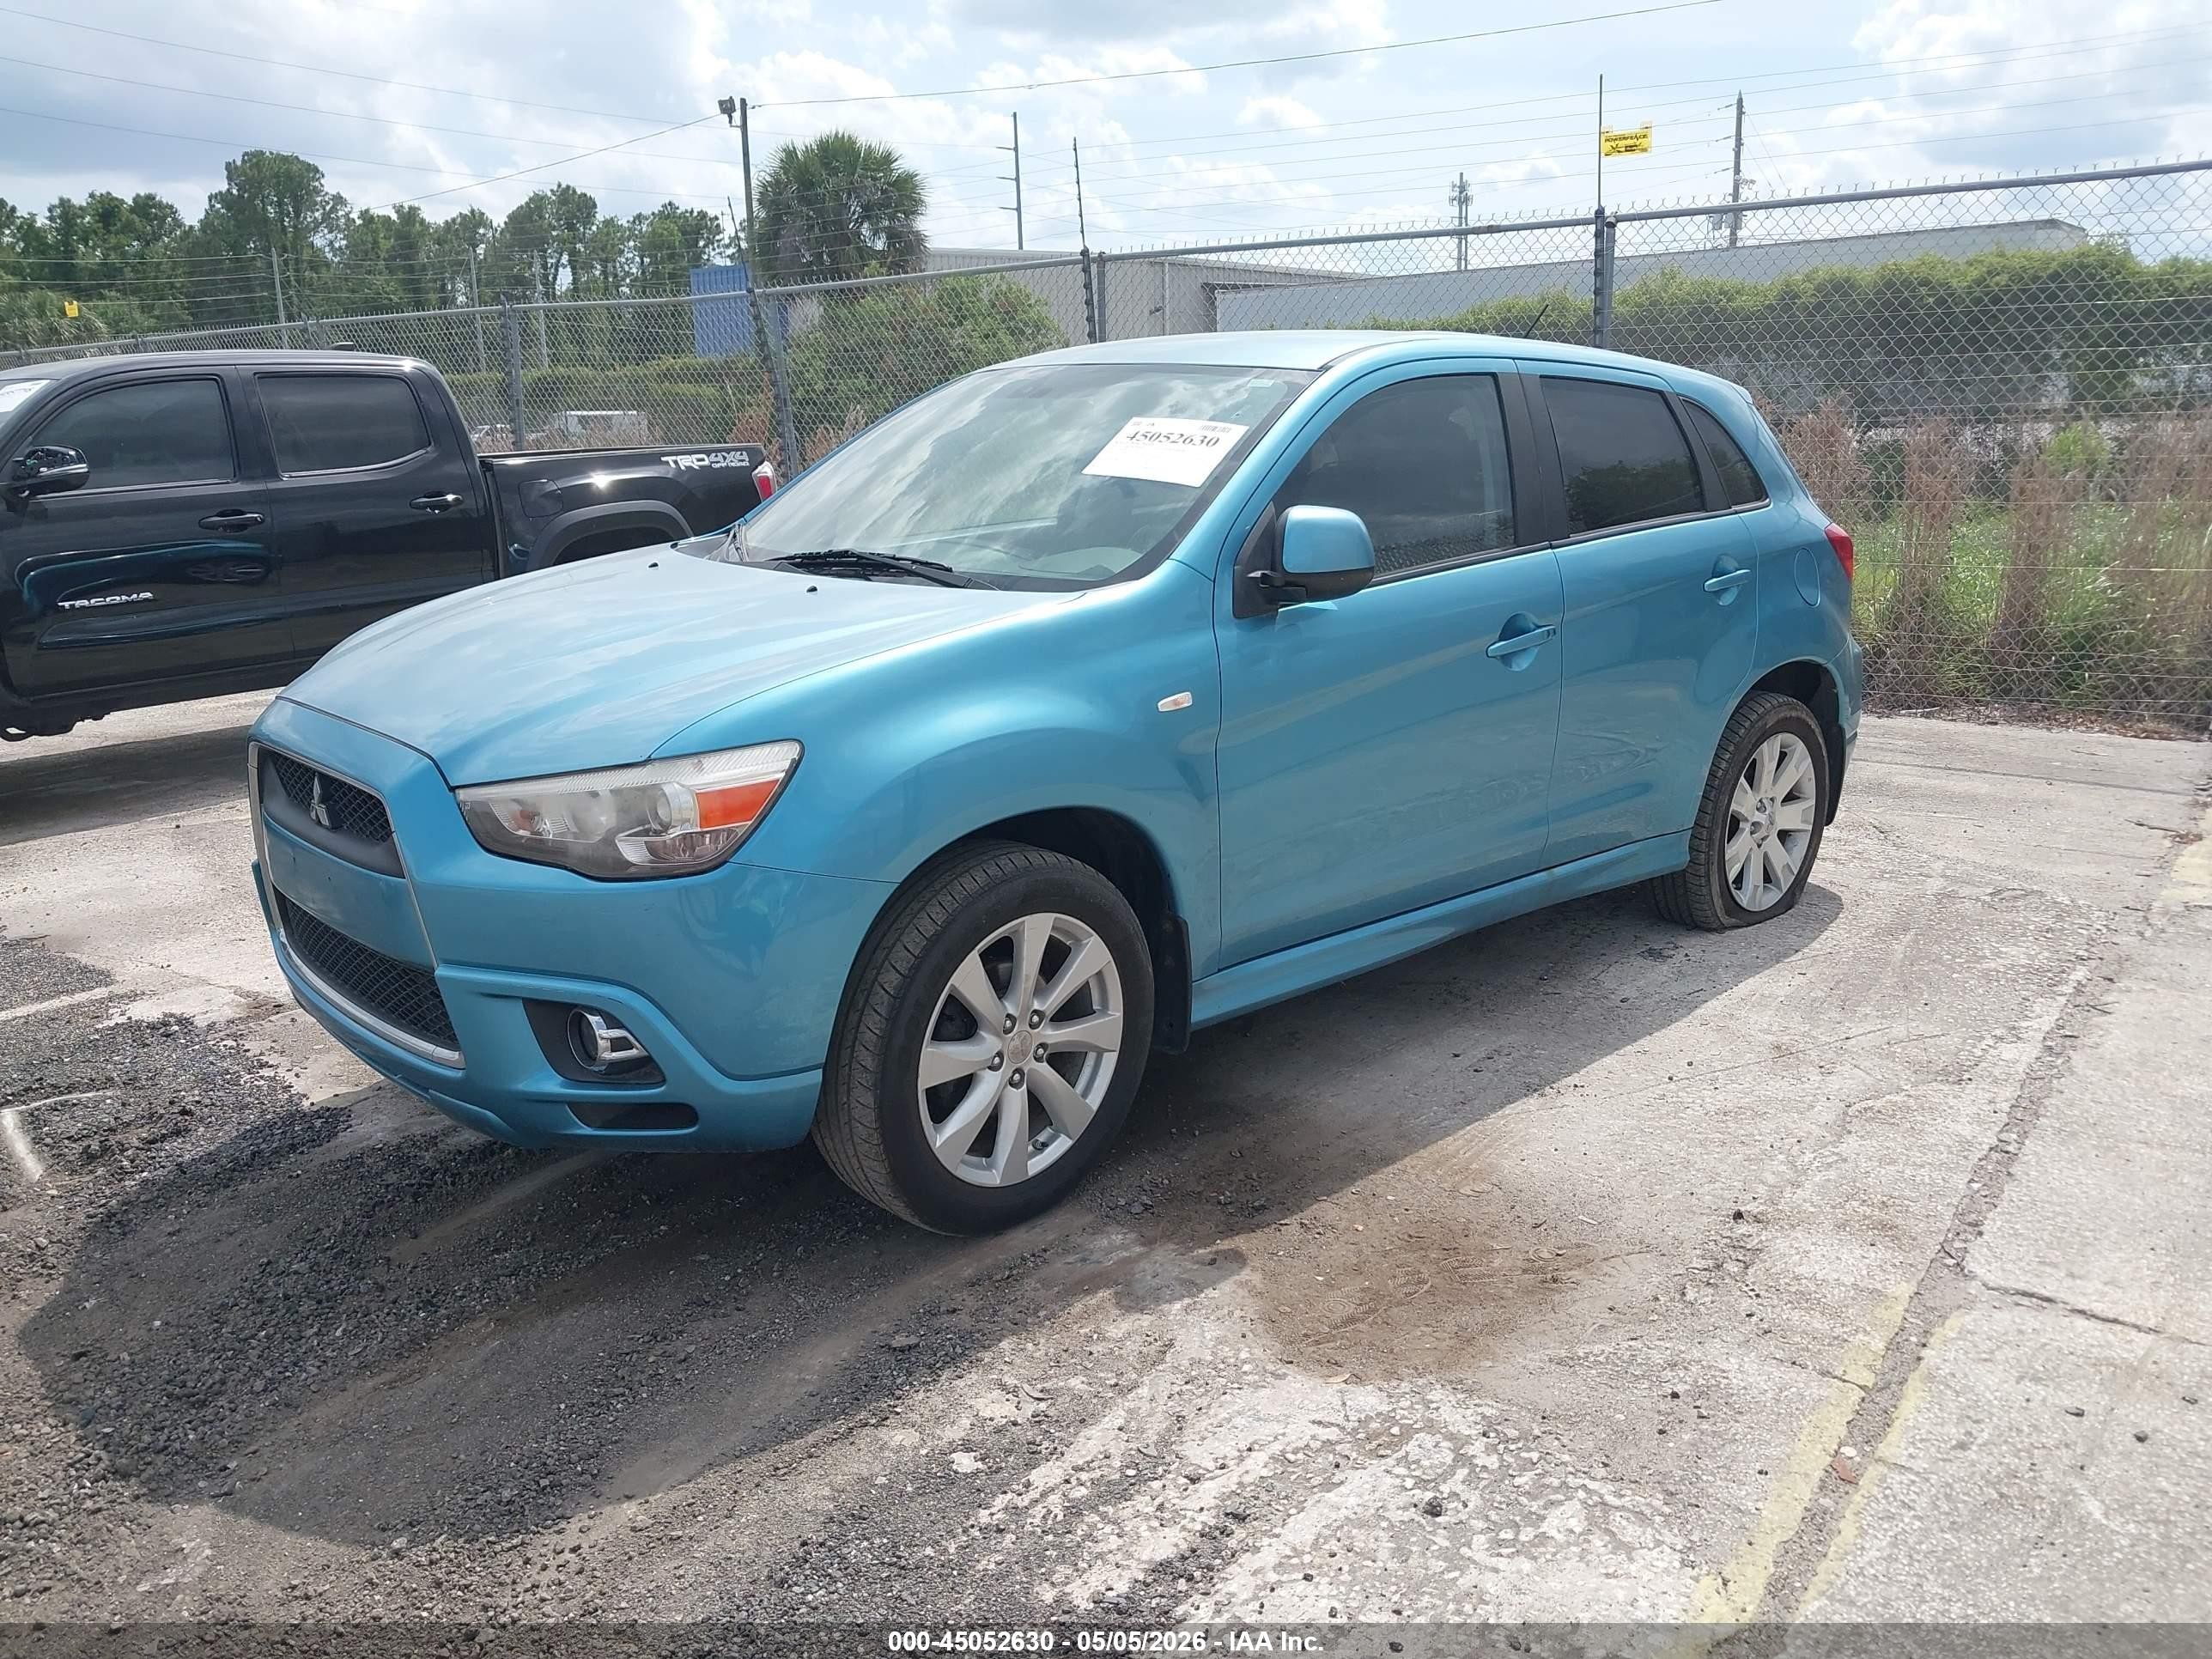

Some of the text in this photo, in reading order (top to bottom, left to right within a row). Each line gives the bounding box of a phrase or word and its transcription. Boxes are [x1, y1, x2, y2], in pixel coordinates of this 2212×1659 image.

[1127, 430, 1220, 447] 45052630
[660, 453, 710, 471] TRD
[57, 592, 155, 610] TACOMA
